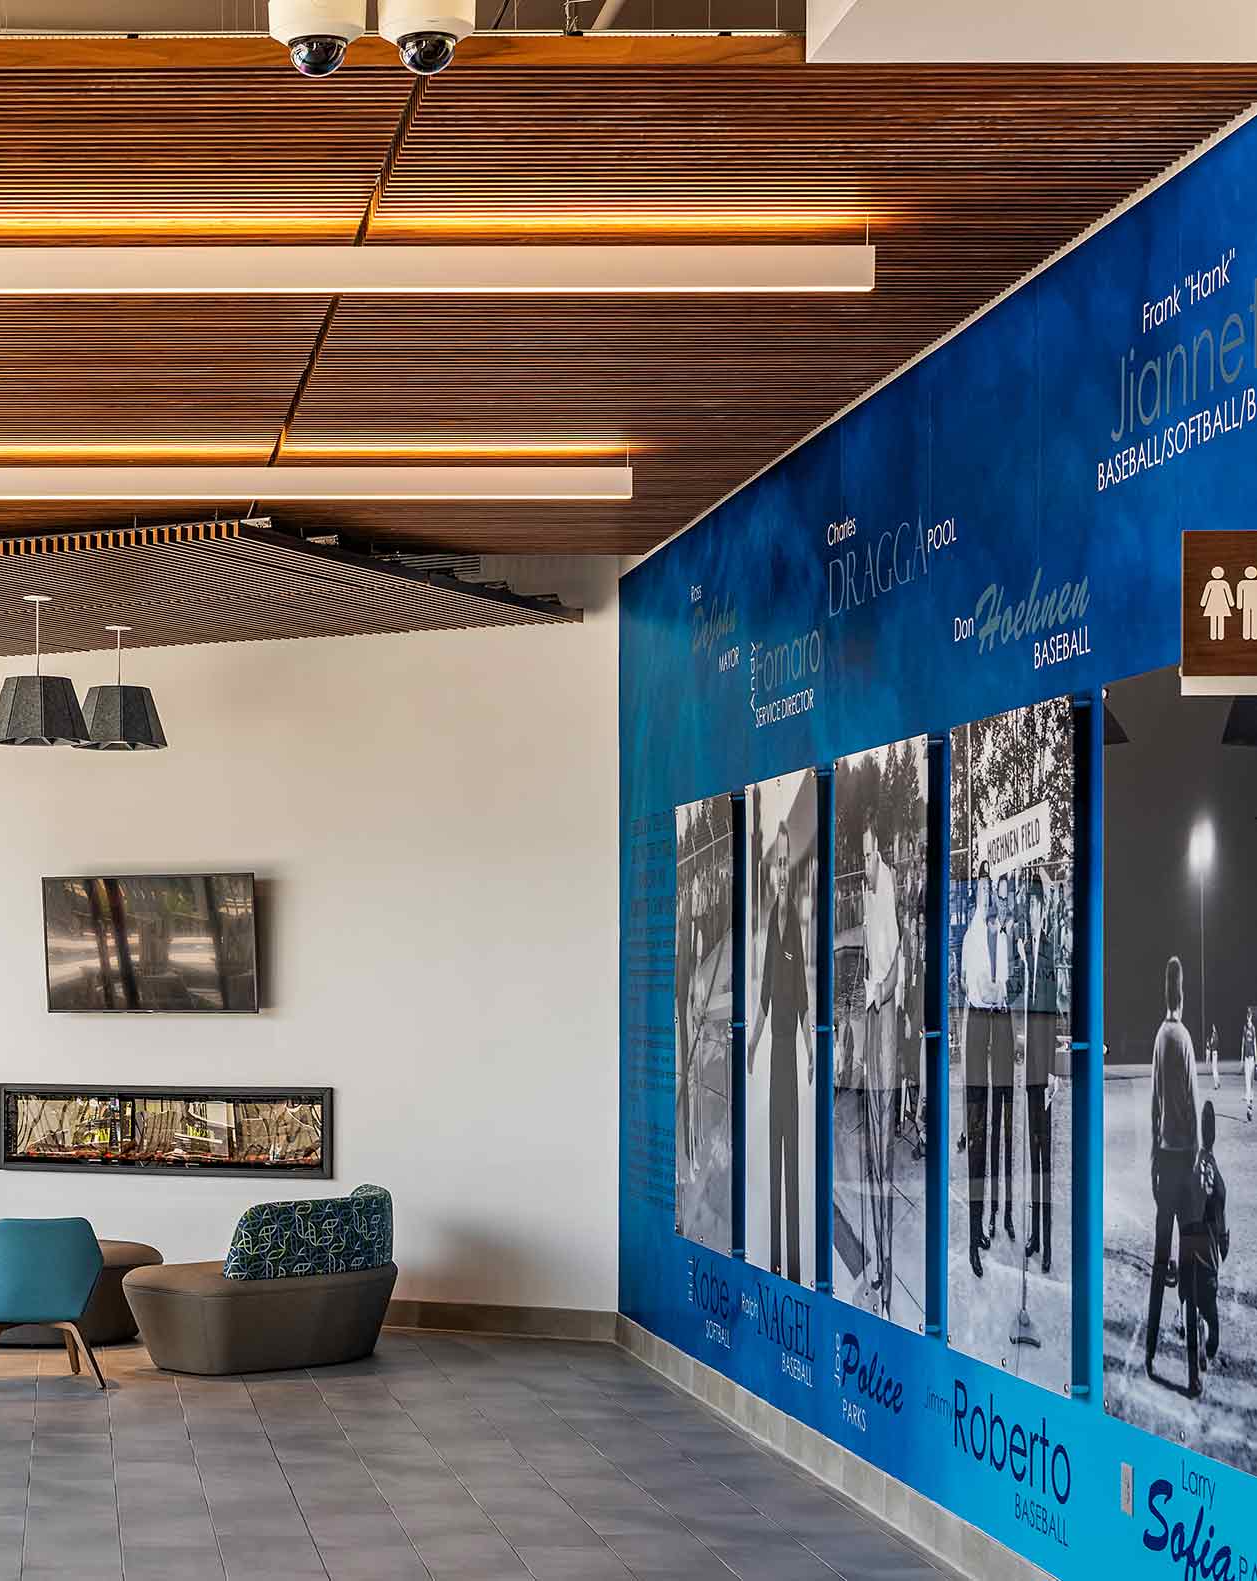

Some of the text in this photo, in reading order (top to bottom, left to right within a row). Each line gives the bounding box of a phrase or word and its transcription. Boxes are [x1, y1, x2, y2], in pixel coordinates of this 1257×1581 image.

[1143, 247, 1236, 334] Frank "Hank"
[827, 515, 856, 546] Charles
[927, 516, 957, 553] POOL
[828, 514, 928, 618] DRAGGA
[954, 567, 1091, 655] Don Hoehnen
[718, 646, 740, 673] MAYOR
[1034, 625, 1091, 669] BASEBALL
[755, 688, 815, 728] SERVICE DIRECTOR
[987, 817, 1040, 868] HOEHNEN FIELD
[694, 1258, 730, 1320] Kobe
[705, 1319, 731, 1350] SOFTBALL
[757, 1281, 816, 1362] NAGEL
[782, 1351, 813, 1388] BASEBALL
[841, 1332, 903, 1414] Police
[843, 1399, 866, 1432] PARKS
[924, 1379, 1071, 1505] Jimmy Roberto
[1182, 1458, 1216, 1511] Larry
[1015, 1492, 1069, 1548] BASEBALL
[1143, 1479, 1236, 1581] Sofia
